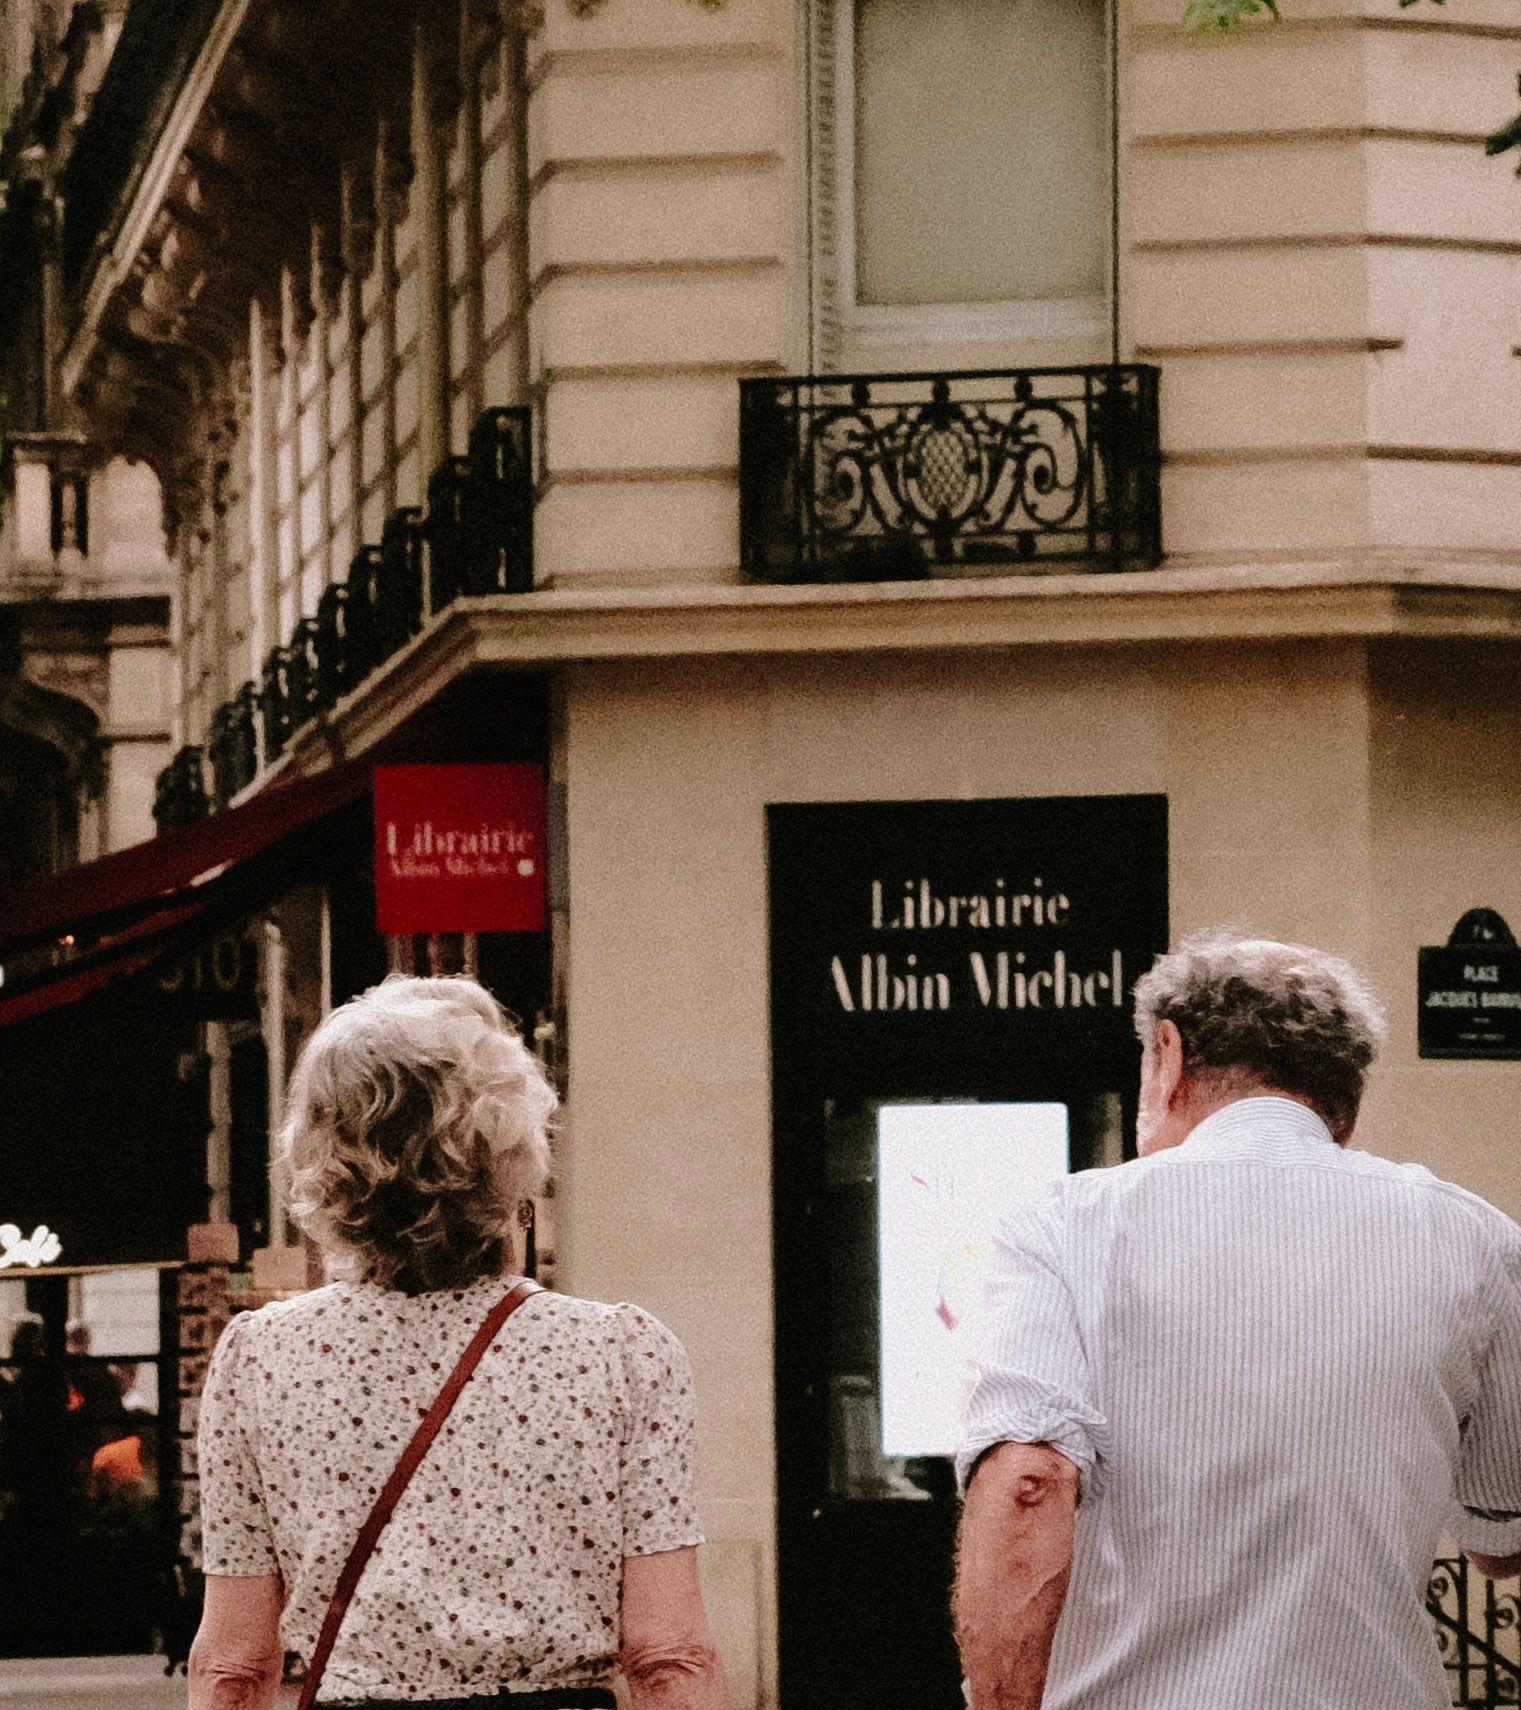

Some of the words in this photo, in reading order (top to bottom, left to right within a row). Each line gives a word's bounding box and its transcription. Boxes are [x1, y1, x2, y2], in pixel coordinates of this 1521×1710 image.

[387, 821, 535, 856] Librairie
[872, 878, 1070, 929] Librairie
[830, 951, 951, 1012] Albin
[970, 949, 1123, 1010] Michel
